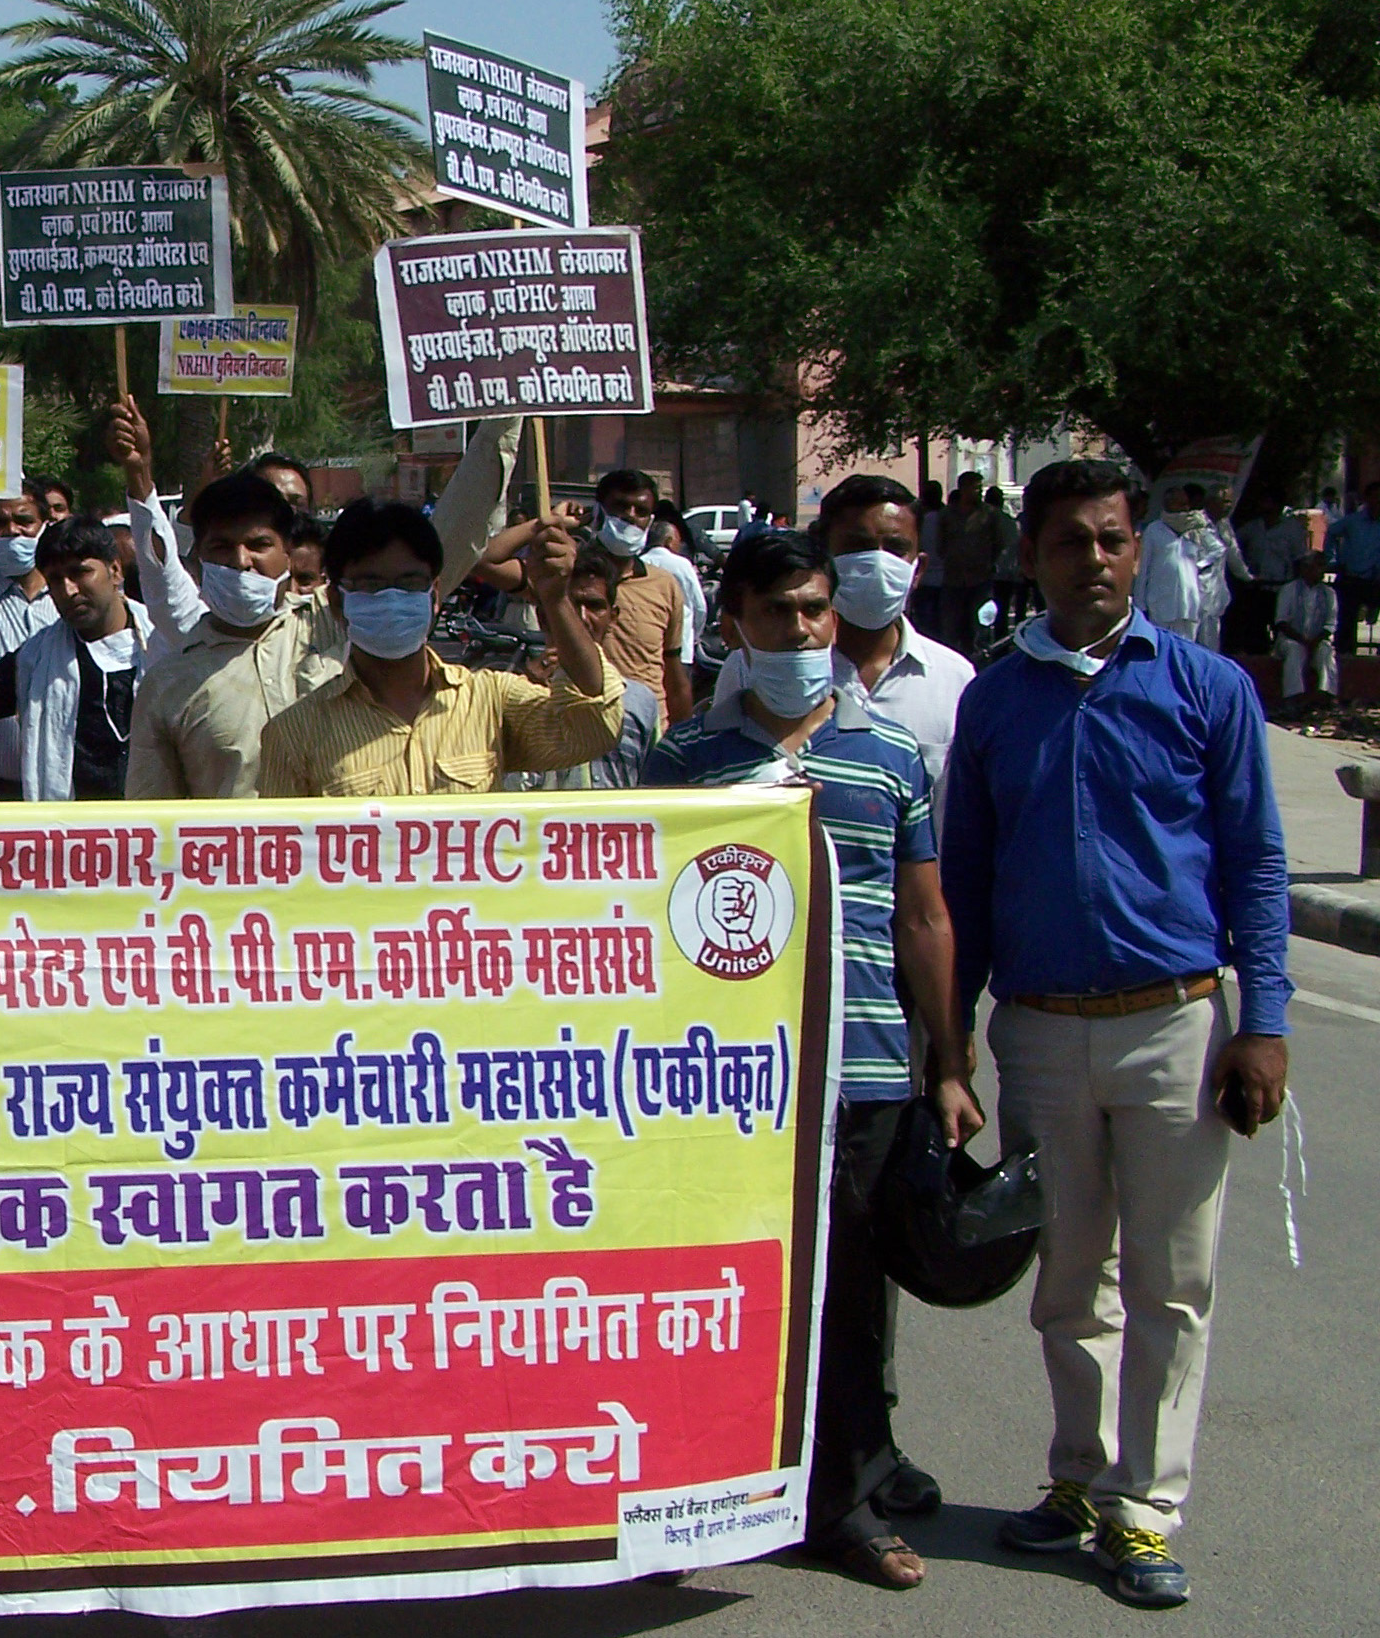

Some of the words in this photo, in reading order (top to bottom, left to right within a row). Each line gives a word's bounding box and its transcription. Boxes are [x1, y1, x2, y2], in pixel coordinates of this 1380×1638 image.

[478, 58, 523, 96] NRHM
[501, 97, 525, 127] PHC
[6, 184, 69, 208] राजस्थान
[72, 180, 135, 204] NRHM
[142, 174, 207, 202] लेखाकार
[101, 210, 137, 235] PHC
[399, 255, 477, 285] राजस्थान
[478, 247, 554, 278] NRHM
[558, 242, 628, 275] लेखाकार
[95, 280, 117, 310] को
[118, 278, 173, 310] नियमित
[175, 278, 204, 307] करो
[516, 284, 558, 313] PHC
[177, 355, 214, 376] NRHM
[518, 368, 544, 404] को
[544, 366, 603, 404] नियमित
[604, 366, 633, 402] करो
[317, 807, 382, 885] एवं
[394, 819, 522, 883] PHC
[542, 822, 658, 879] आशा
[702, 846, 770, 871] एकीकृत
[98, 911, 157, 1003] एवं
[522, 906, 658, 999] महासंघ
[701, 947, 771, 973] United
[4, 1059, 110, 1139] राज्य
[121, 1037, 267, 1160] संयुक्त
[275, 1031, 449, 1128] कर्मचारी
[457, 1027, 608, 1126] महासंघ
[614, 1025, 789, 1135] (एकीकृत)
[90, 1169, 322, 1245] स्वागत
[339, 1160, 532, 1236] करता
[526, 1137, 593, 1229] है
[64, 1296, 129, 1387] के
[148, 1308, 326, 1382] आधार
[339, 1302, 417, 1372] पर
[426, 1276, 644, 1369] नियमित
[651, 1267, 745, 1358] करो
[46, 1417, 452, 1514] नियमित
[465, 1401, 647, 1491] करो
